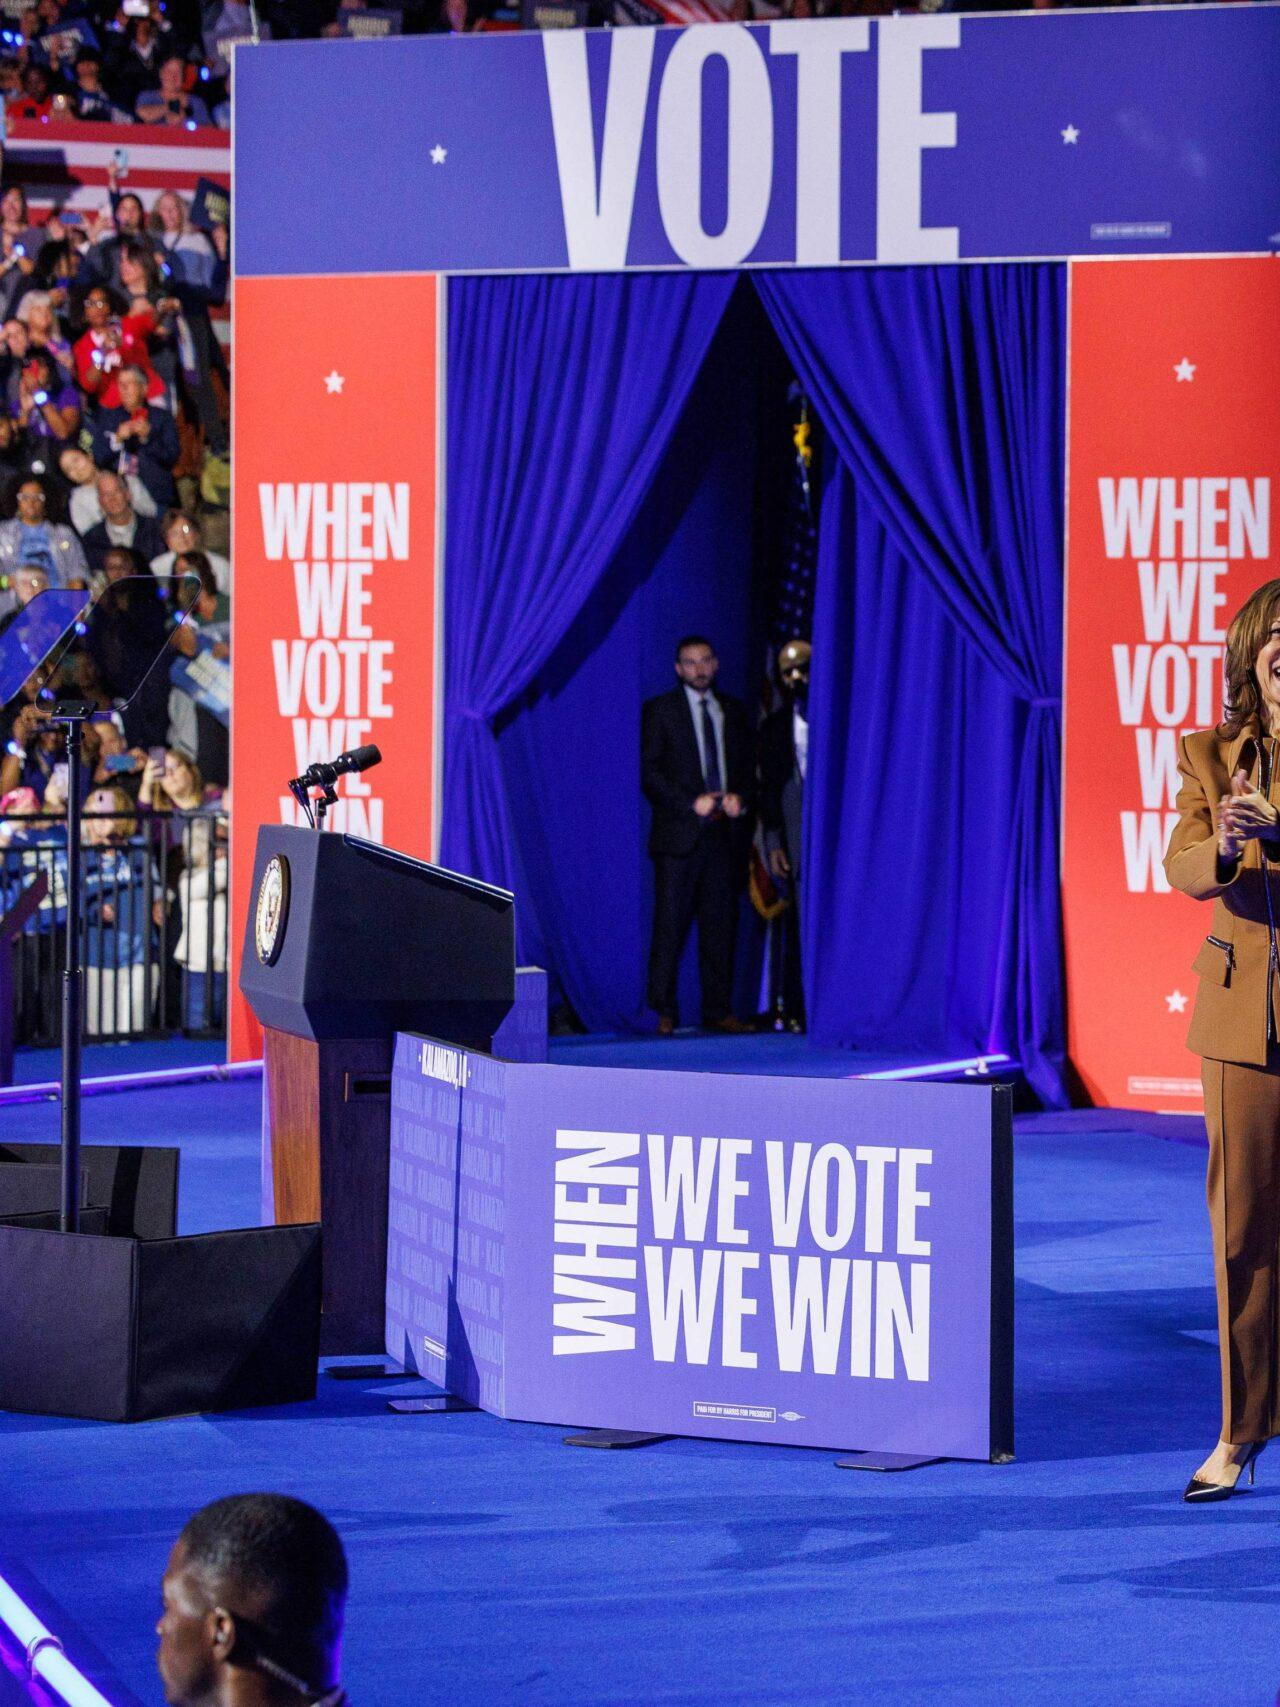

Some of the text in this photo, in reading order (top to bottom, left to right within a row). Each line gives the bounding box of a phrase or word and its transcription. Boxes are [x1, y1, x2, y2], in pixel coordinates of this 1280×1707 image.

[542, 17, 961, 269] VOTE
[258, 482, 410, 561] WHEN
[1098, 477, 1270, 559] WHEN
[293, 562, 373, 639] WE
[1138, 561, 1228, 642] WE
[271, 639, 394, 718] VOTE
[1112, 644, 1226, 726] VOT
[292, 719, 371, 796] WE
[646, 1134, 932, 1256] WE VOTE
[553, 1129, 640, 1356] WHEN
[644, 1245, 760, 1369] WE
[769, 1254, 931, 1382] WIN
[697, 1405, 772, 1419] PAID FOR BY HARRIS FOR PRESIDENT
